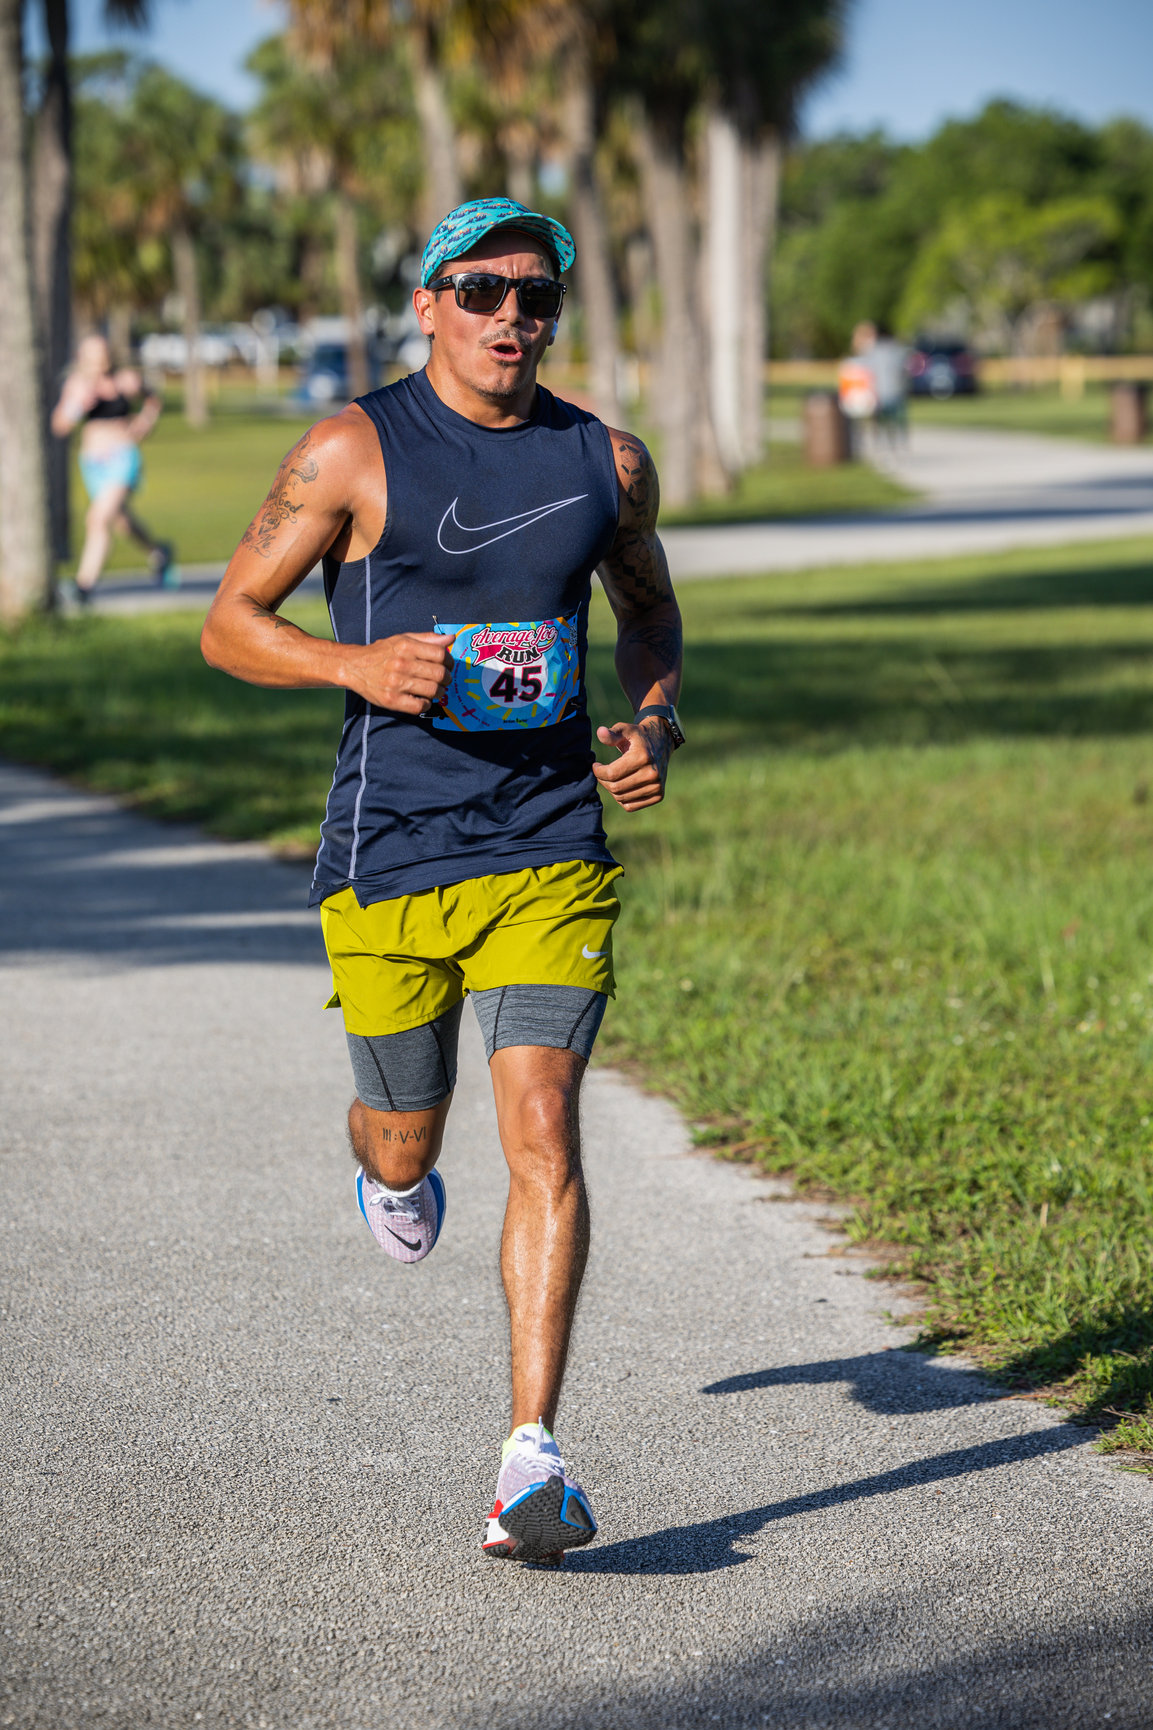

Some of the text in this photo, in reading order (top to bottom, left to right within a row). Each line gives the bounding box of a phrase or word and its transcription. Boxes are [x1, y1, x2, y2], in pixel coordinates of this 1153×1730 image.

[471, 624, 555, 647] Average Joe
[497, 645, 540, 663] RUN
[490, 665, 542, 703] 45
